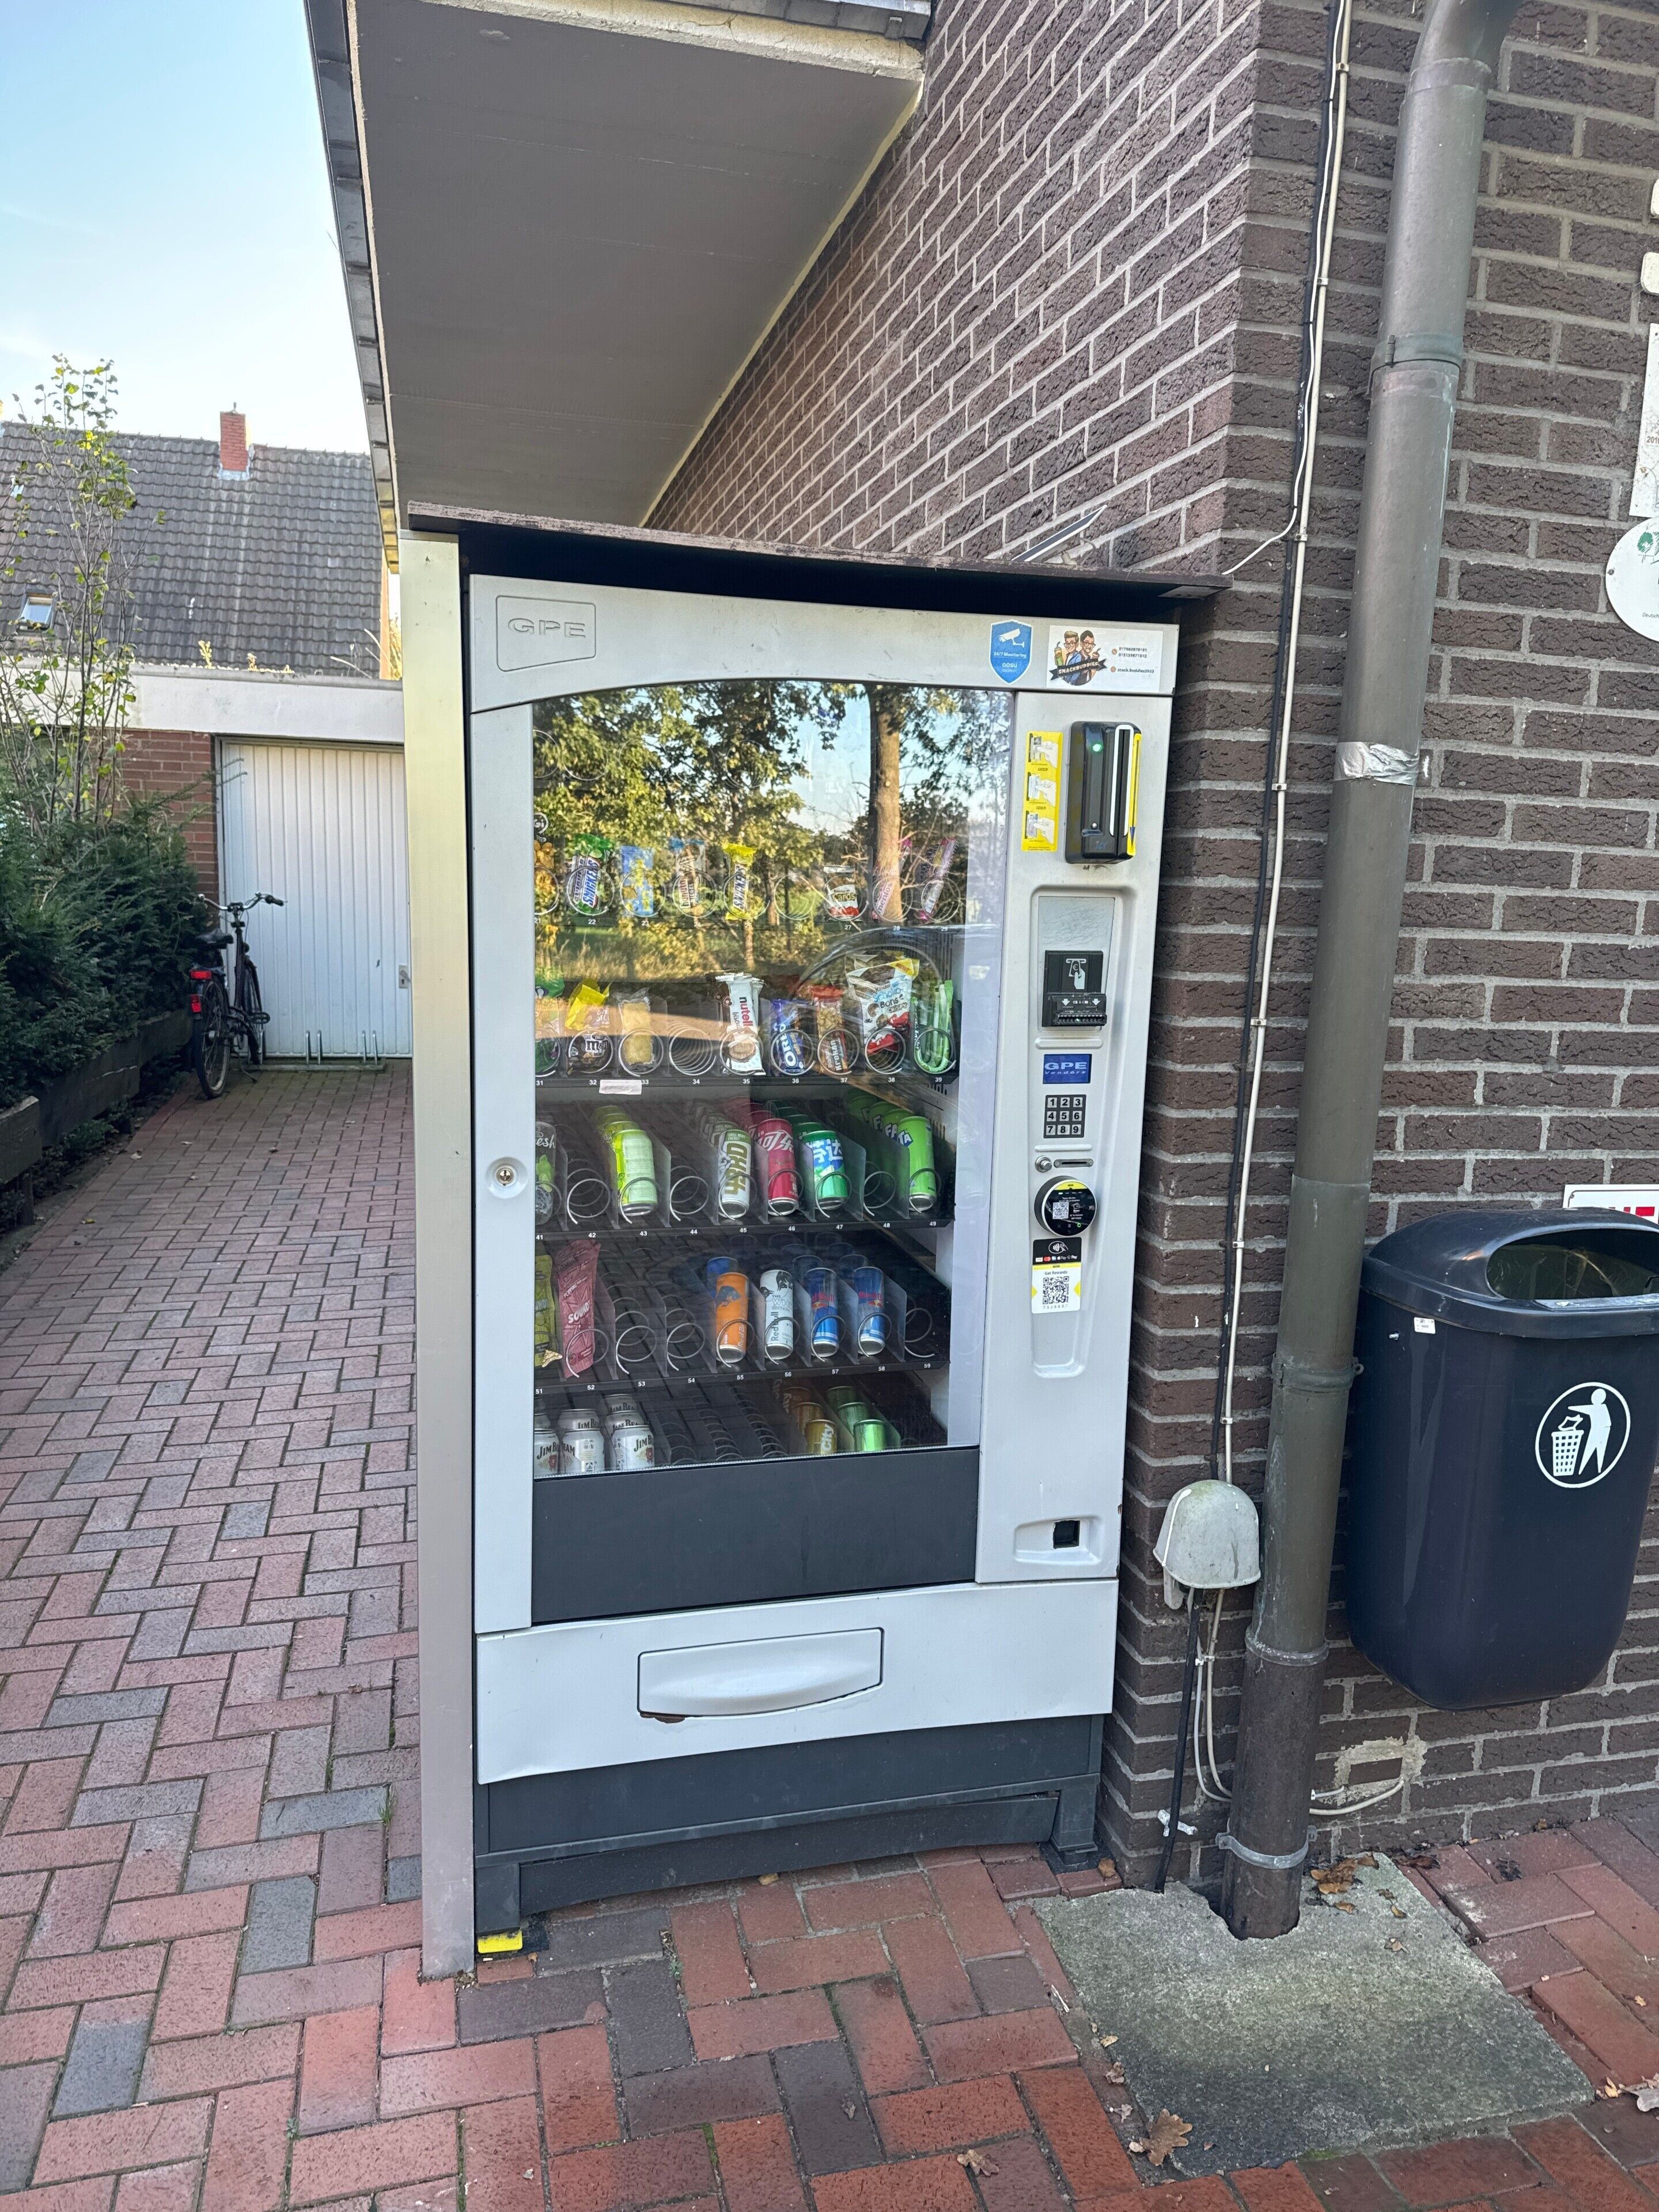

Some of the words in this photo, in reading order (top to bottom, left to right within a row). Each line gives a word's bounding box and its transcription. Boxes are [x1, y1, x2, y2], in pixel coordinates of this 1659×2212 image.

[507, 618, 586, 638] GPE
[1058, 662, 1099, 674] SNACKBUDDIES
[582, 859, 599, 907] SNICKERS
[877, 882, 893, 914] mentos
[880, 997, 899, 1008] Bons
[739, 996, 753, 1027] nutell
[1044, 1062, 1088, 1070] GPE
[1050, 1098, 1055, 1106] 1
[1062, 1098, 1068, 1106] 2
[1075, 1098, 1081, 1106] 3
[1048, 1112, 1054, 1120] 4
[1061, 1112, 1067, 1120] 5
[1074, 1112, 1080, 1120] 6
[568, 1301, 590, 1324] SOUND
[770, 1327, 779, 1342] Red
[634, 1438, 647, 1452] JIM
[820, 1423, 835, 1452] City
[536, 1445, 552, 1460] JIM
